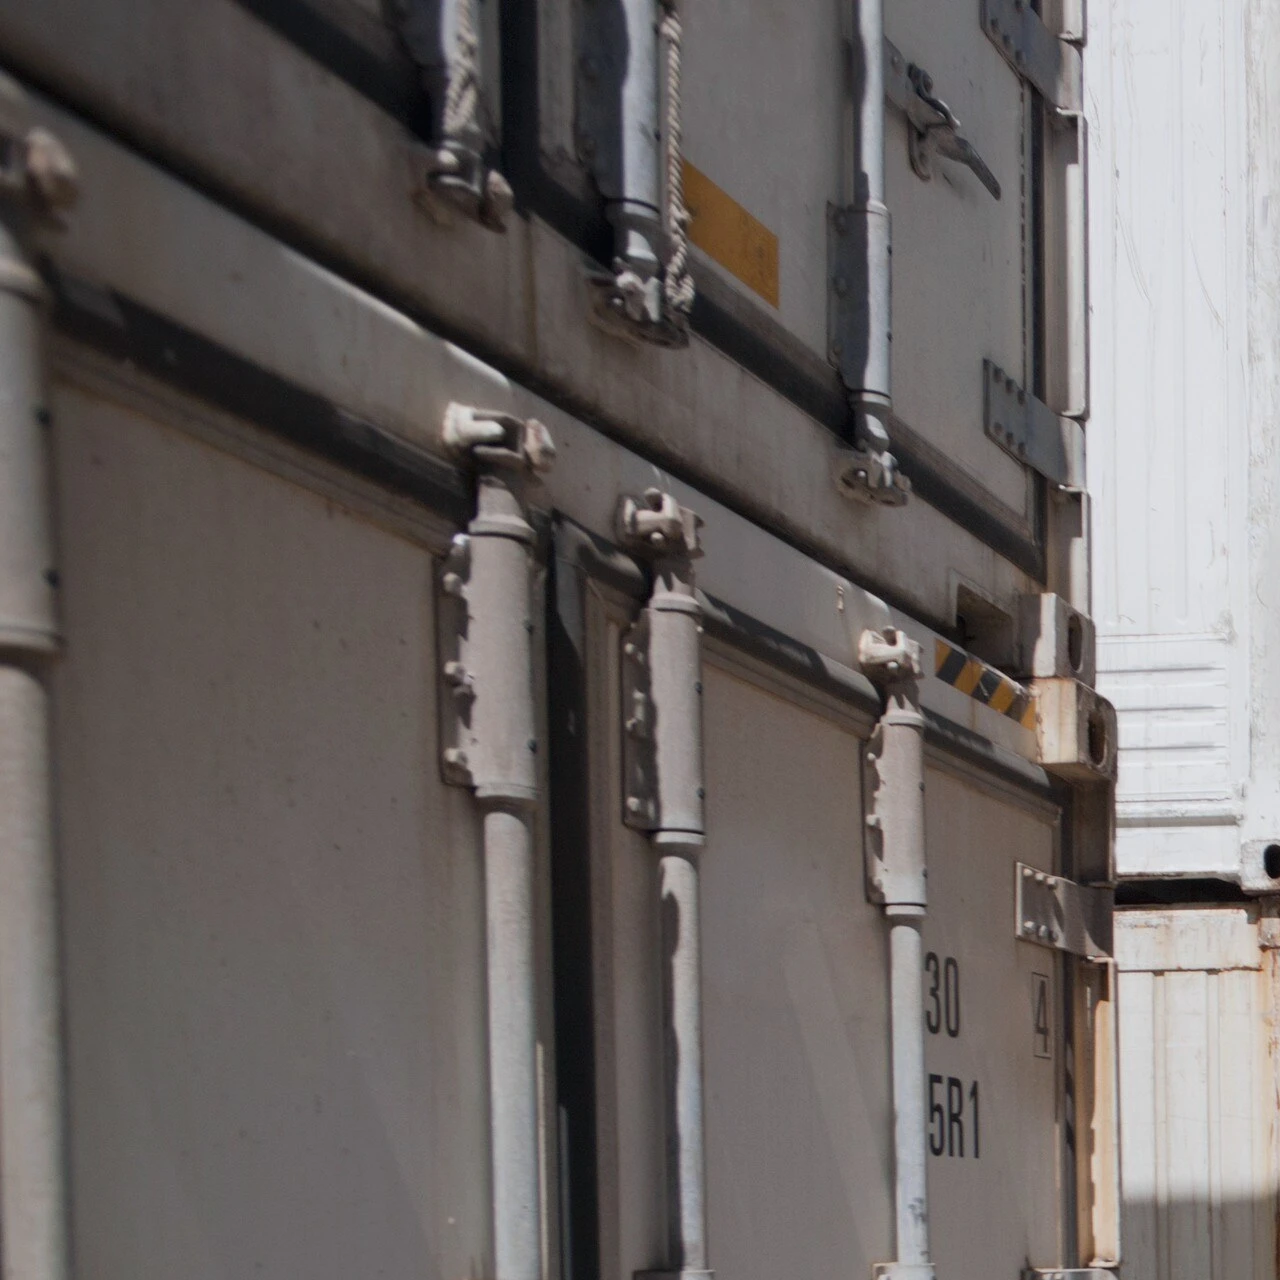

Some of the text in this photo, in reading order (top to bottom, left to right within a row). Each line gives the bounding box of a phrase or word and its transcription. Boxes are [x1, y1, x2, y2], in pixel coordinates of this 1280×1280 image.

[925, 951, 960, 1038] 30
[1034, 979, 1049, 1054] 4
[928, 1073, 980, 1159] 5R1
